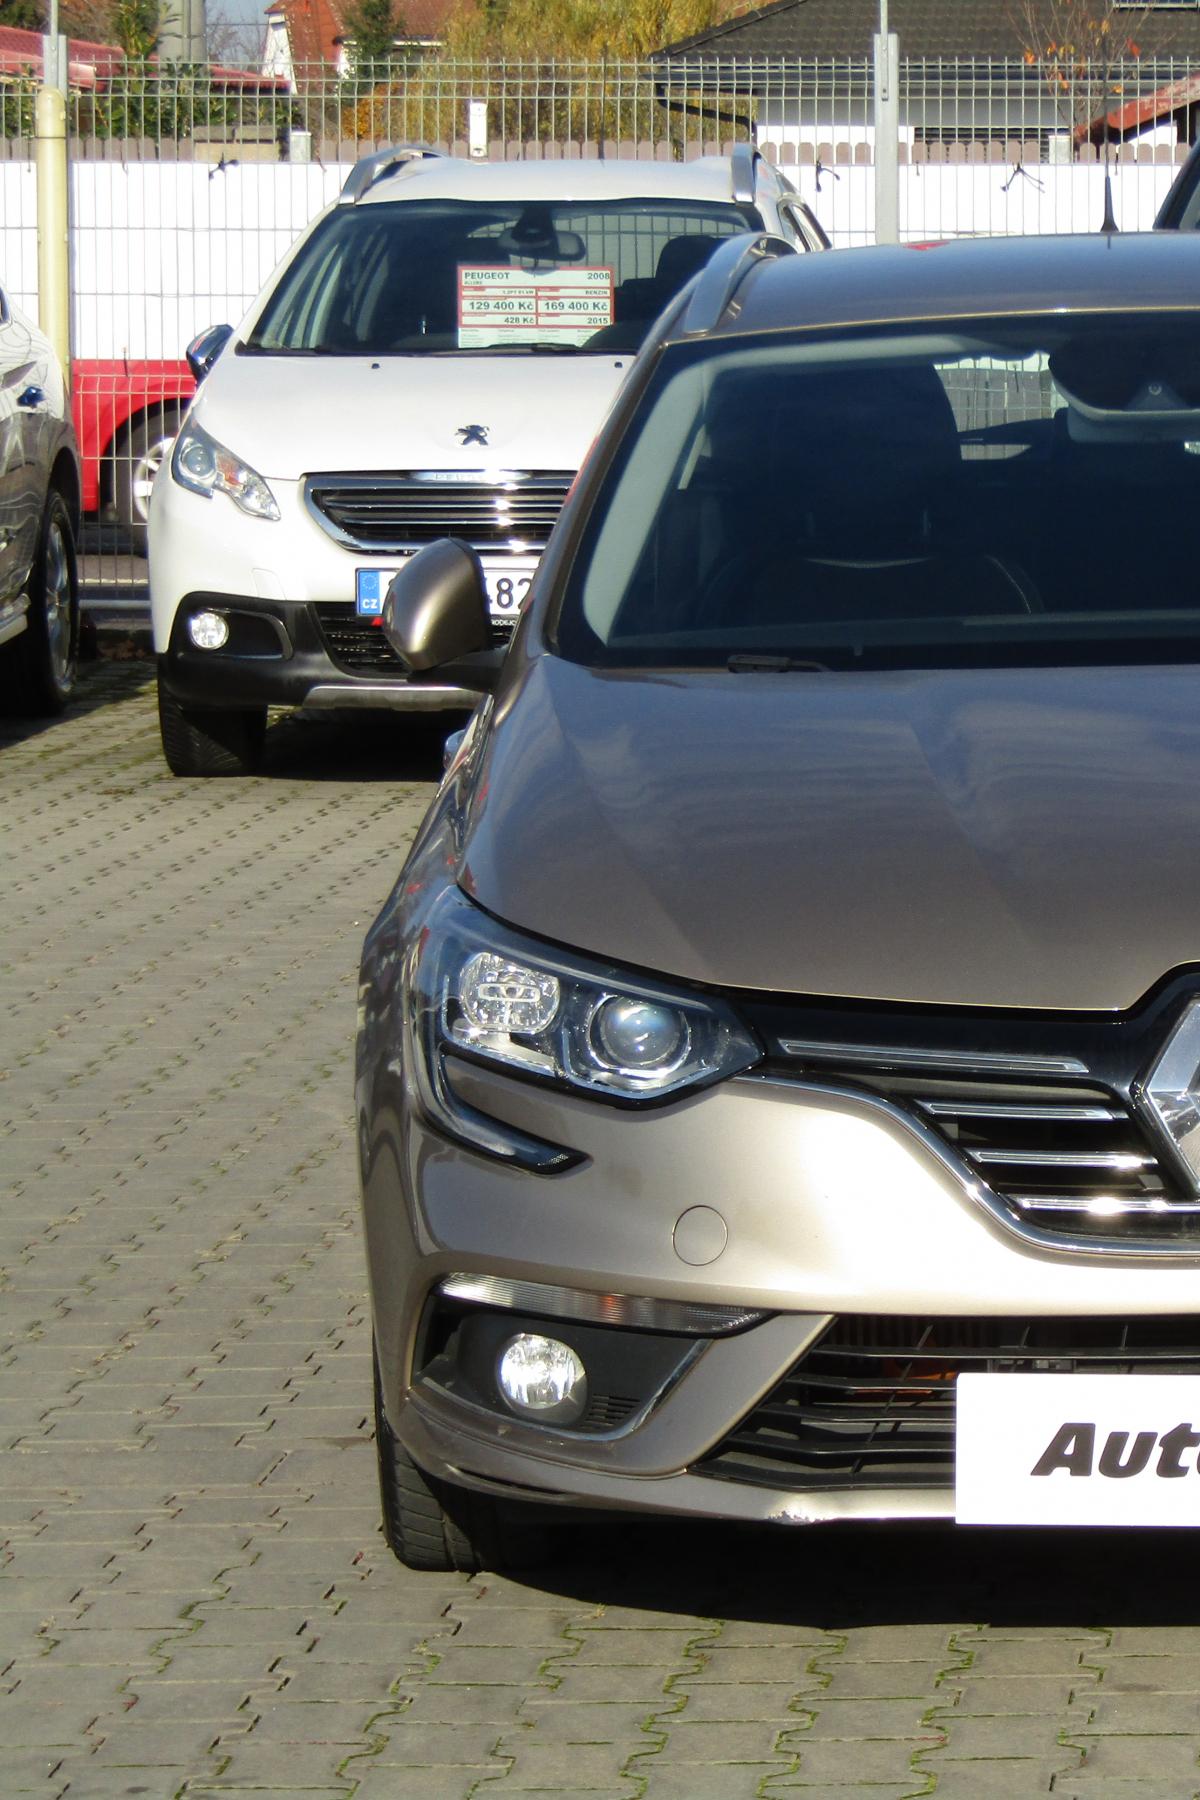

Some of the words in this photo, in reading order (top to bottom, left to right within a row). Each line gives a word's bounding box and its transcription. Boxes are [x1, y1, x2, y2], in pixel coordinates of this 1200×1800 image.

[464, 272, 510, 280] PEUGEOT
[587, 272, 610, 280] 2008
[469, 302, 490, 310] 129
[493, 302, 514, 310] 400
[518, 301, 534, 310] Kč
[545, 302, 565, 310] 169
[568, 302, 589, 310] 400
[593, 301, 608, 310] Kč
[523, 316, 534, 324] Kč
[362, 598, 378, 609] CZ
